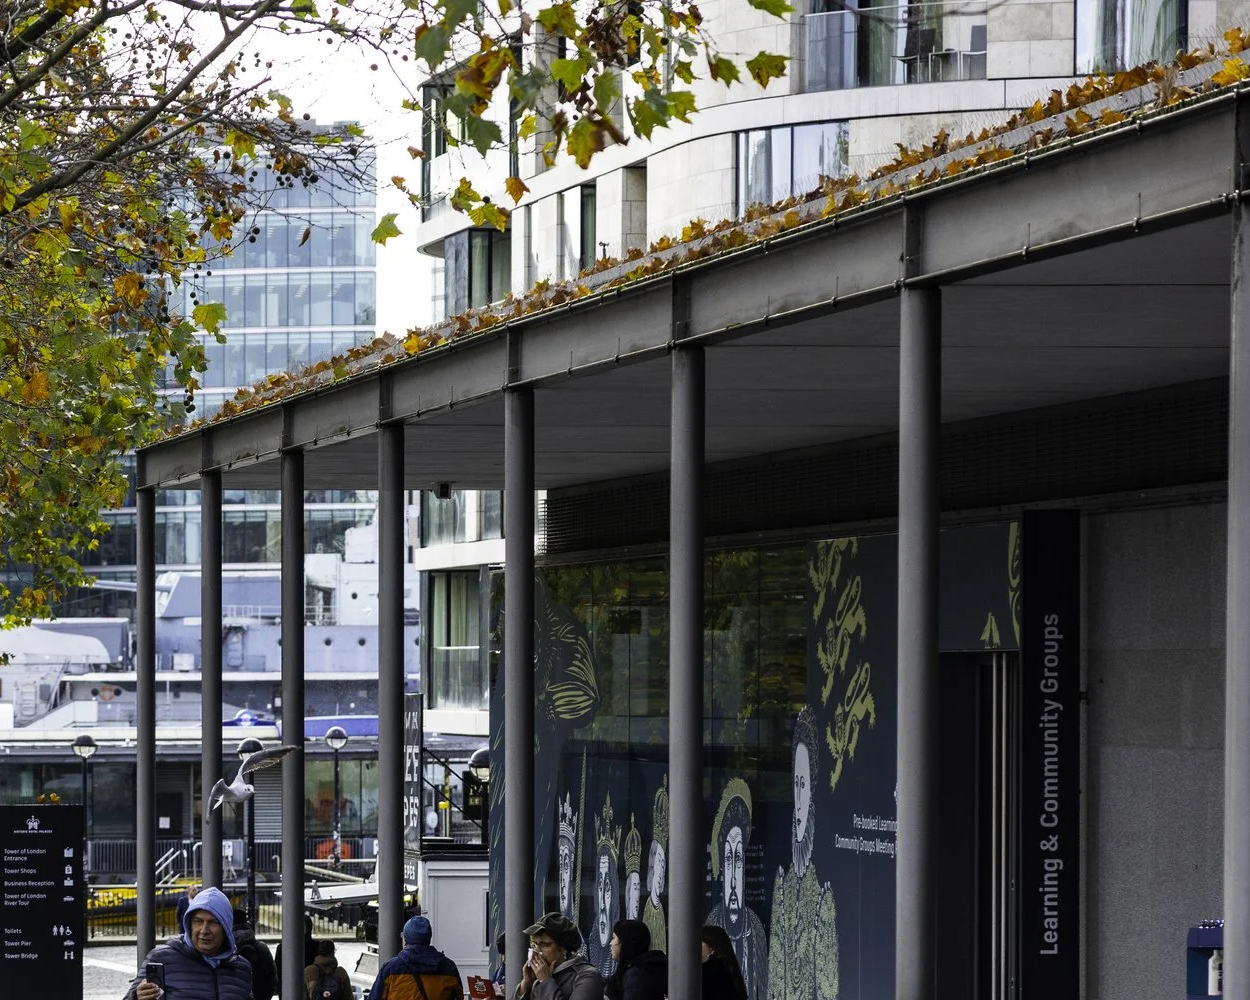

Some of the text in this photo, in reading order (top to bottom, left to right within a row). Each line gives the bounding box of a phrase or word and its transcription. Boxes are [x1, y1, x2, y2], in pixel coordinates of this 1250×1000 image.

[1039, 614, 1064, 955] Learning & Community Groups
[853, 814, 878, 830] Pre-booked
[835, 834, 859, 854] Community
[860, 836, 875, 856] Groups
[876, 838, 895, 858] Meeting
